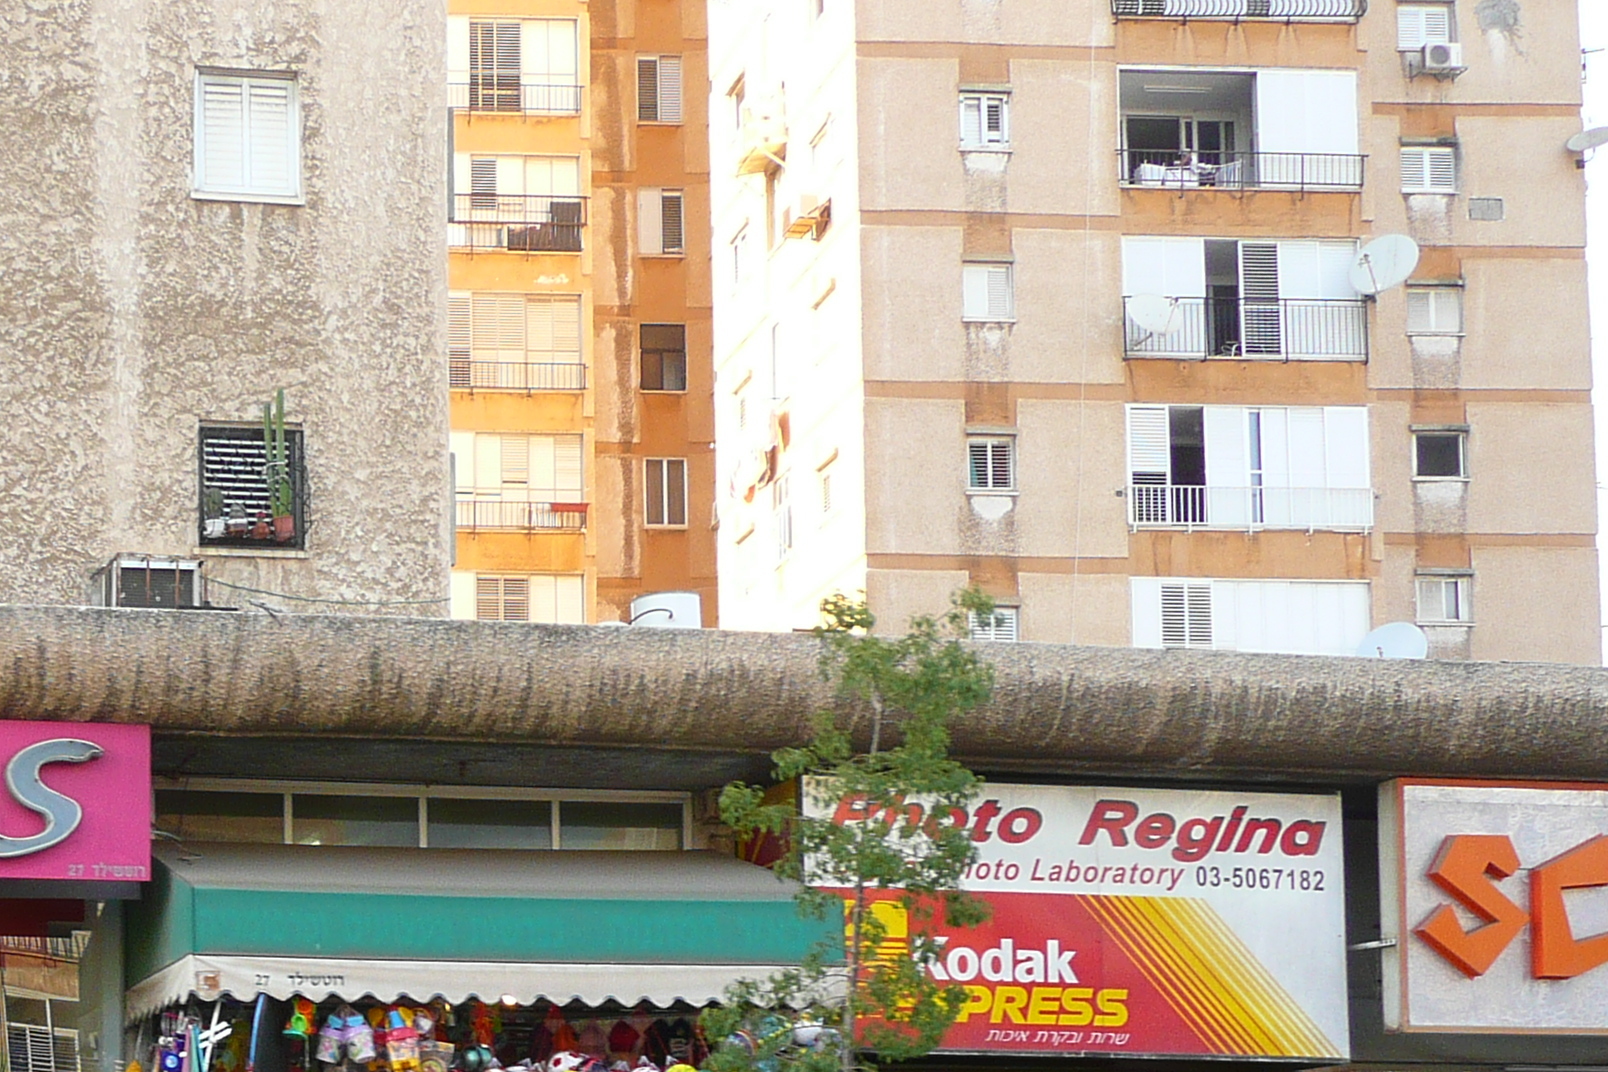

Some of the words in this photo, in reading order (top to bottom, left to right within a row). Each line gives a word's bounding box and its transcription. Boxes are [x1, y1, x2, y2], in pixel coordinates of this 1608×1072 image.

[1078, 799, 1327, 862] Regina
[1030, 857, 1185, 892] Laboratory
[1195, 865, 1326, 892] 03-5067182
[255, 974, 271, 987] 27
[892, 985, 1130, 1027] PRESS
[985, 1029, 1030, 1042] איכות
[1033, 1030, 1083, 1046] ובקרת
[1087, 1031, 1130, 1046] שרות
